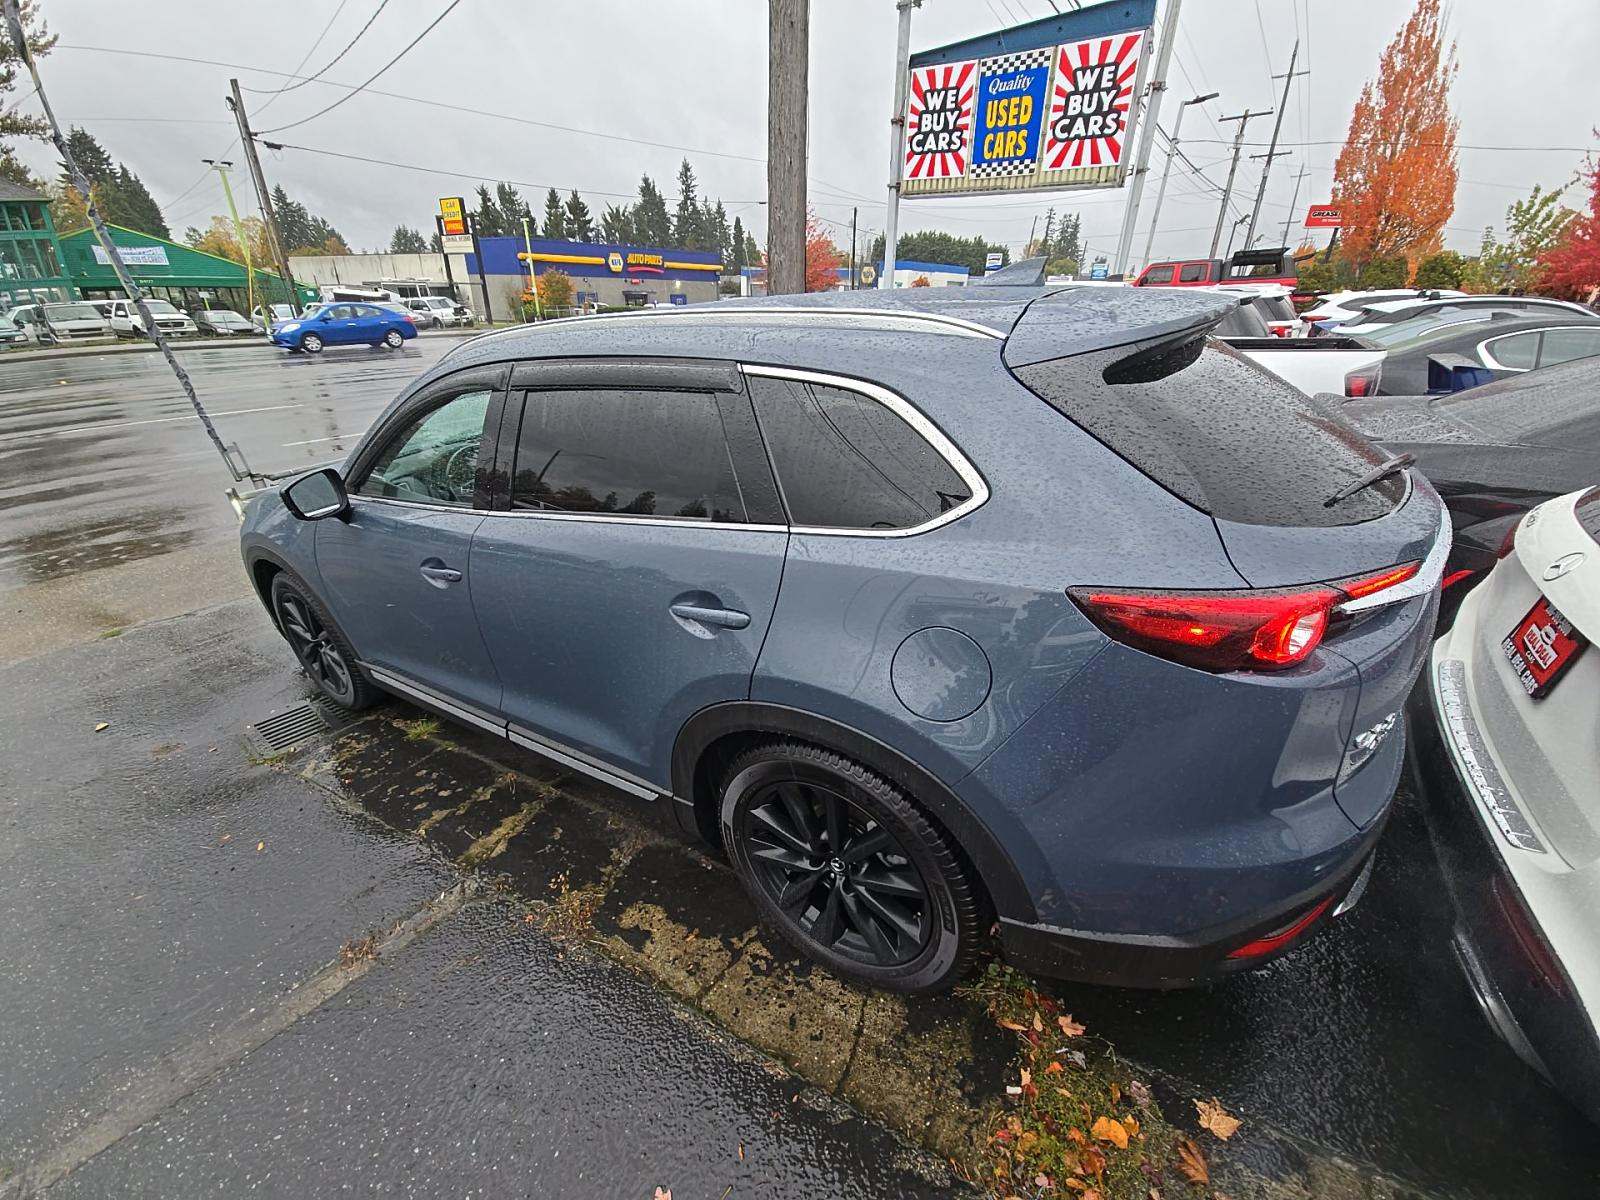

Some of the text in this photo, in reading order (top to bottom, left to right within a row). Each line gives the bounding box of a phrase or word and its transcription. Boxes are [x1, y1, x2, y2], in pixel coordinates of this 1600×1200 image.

[989, 74, 1034, 95] Quality
[1076, 65, 1116, 92] WE
[926, 90, 958, 111] WE
[986, 95, 1033, 129] USED
[1067, 89, 1118, 116] BUY
[921, 110, 960, 132] BUY
[1054, 113, 1119, 140] CARS
[911, 131, 962, 153] CARS
[983, 129, 1028, 160] CARS
[628, 253, 644, 264] AUTO
[645, 254, 662, 265] PARTS
[1526, 630, 1552, 666] REAL DEAL
[1501, 638, 1538, 694] REAL DEAL CARS
